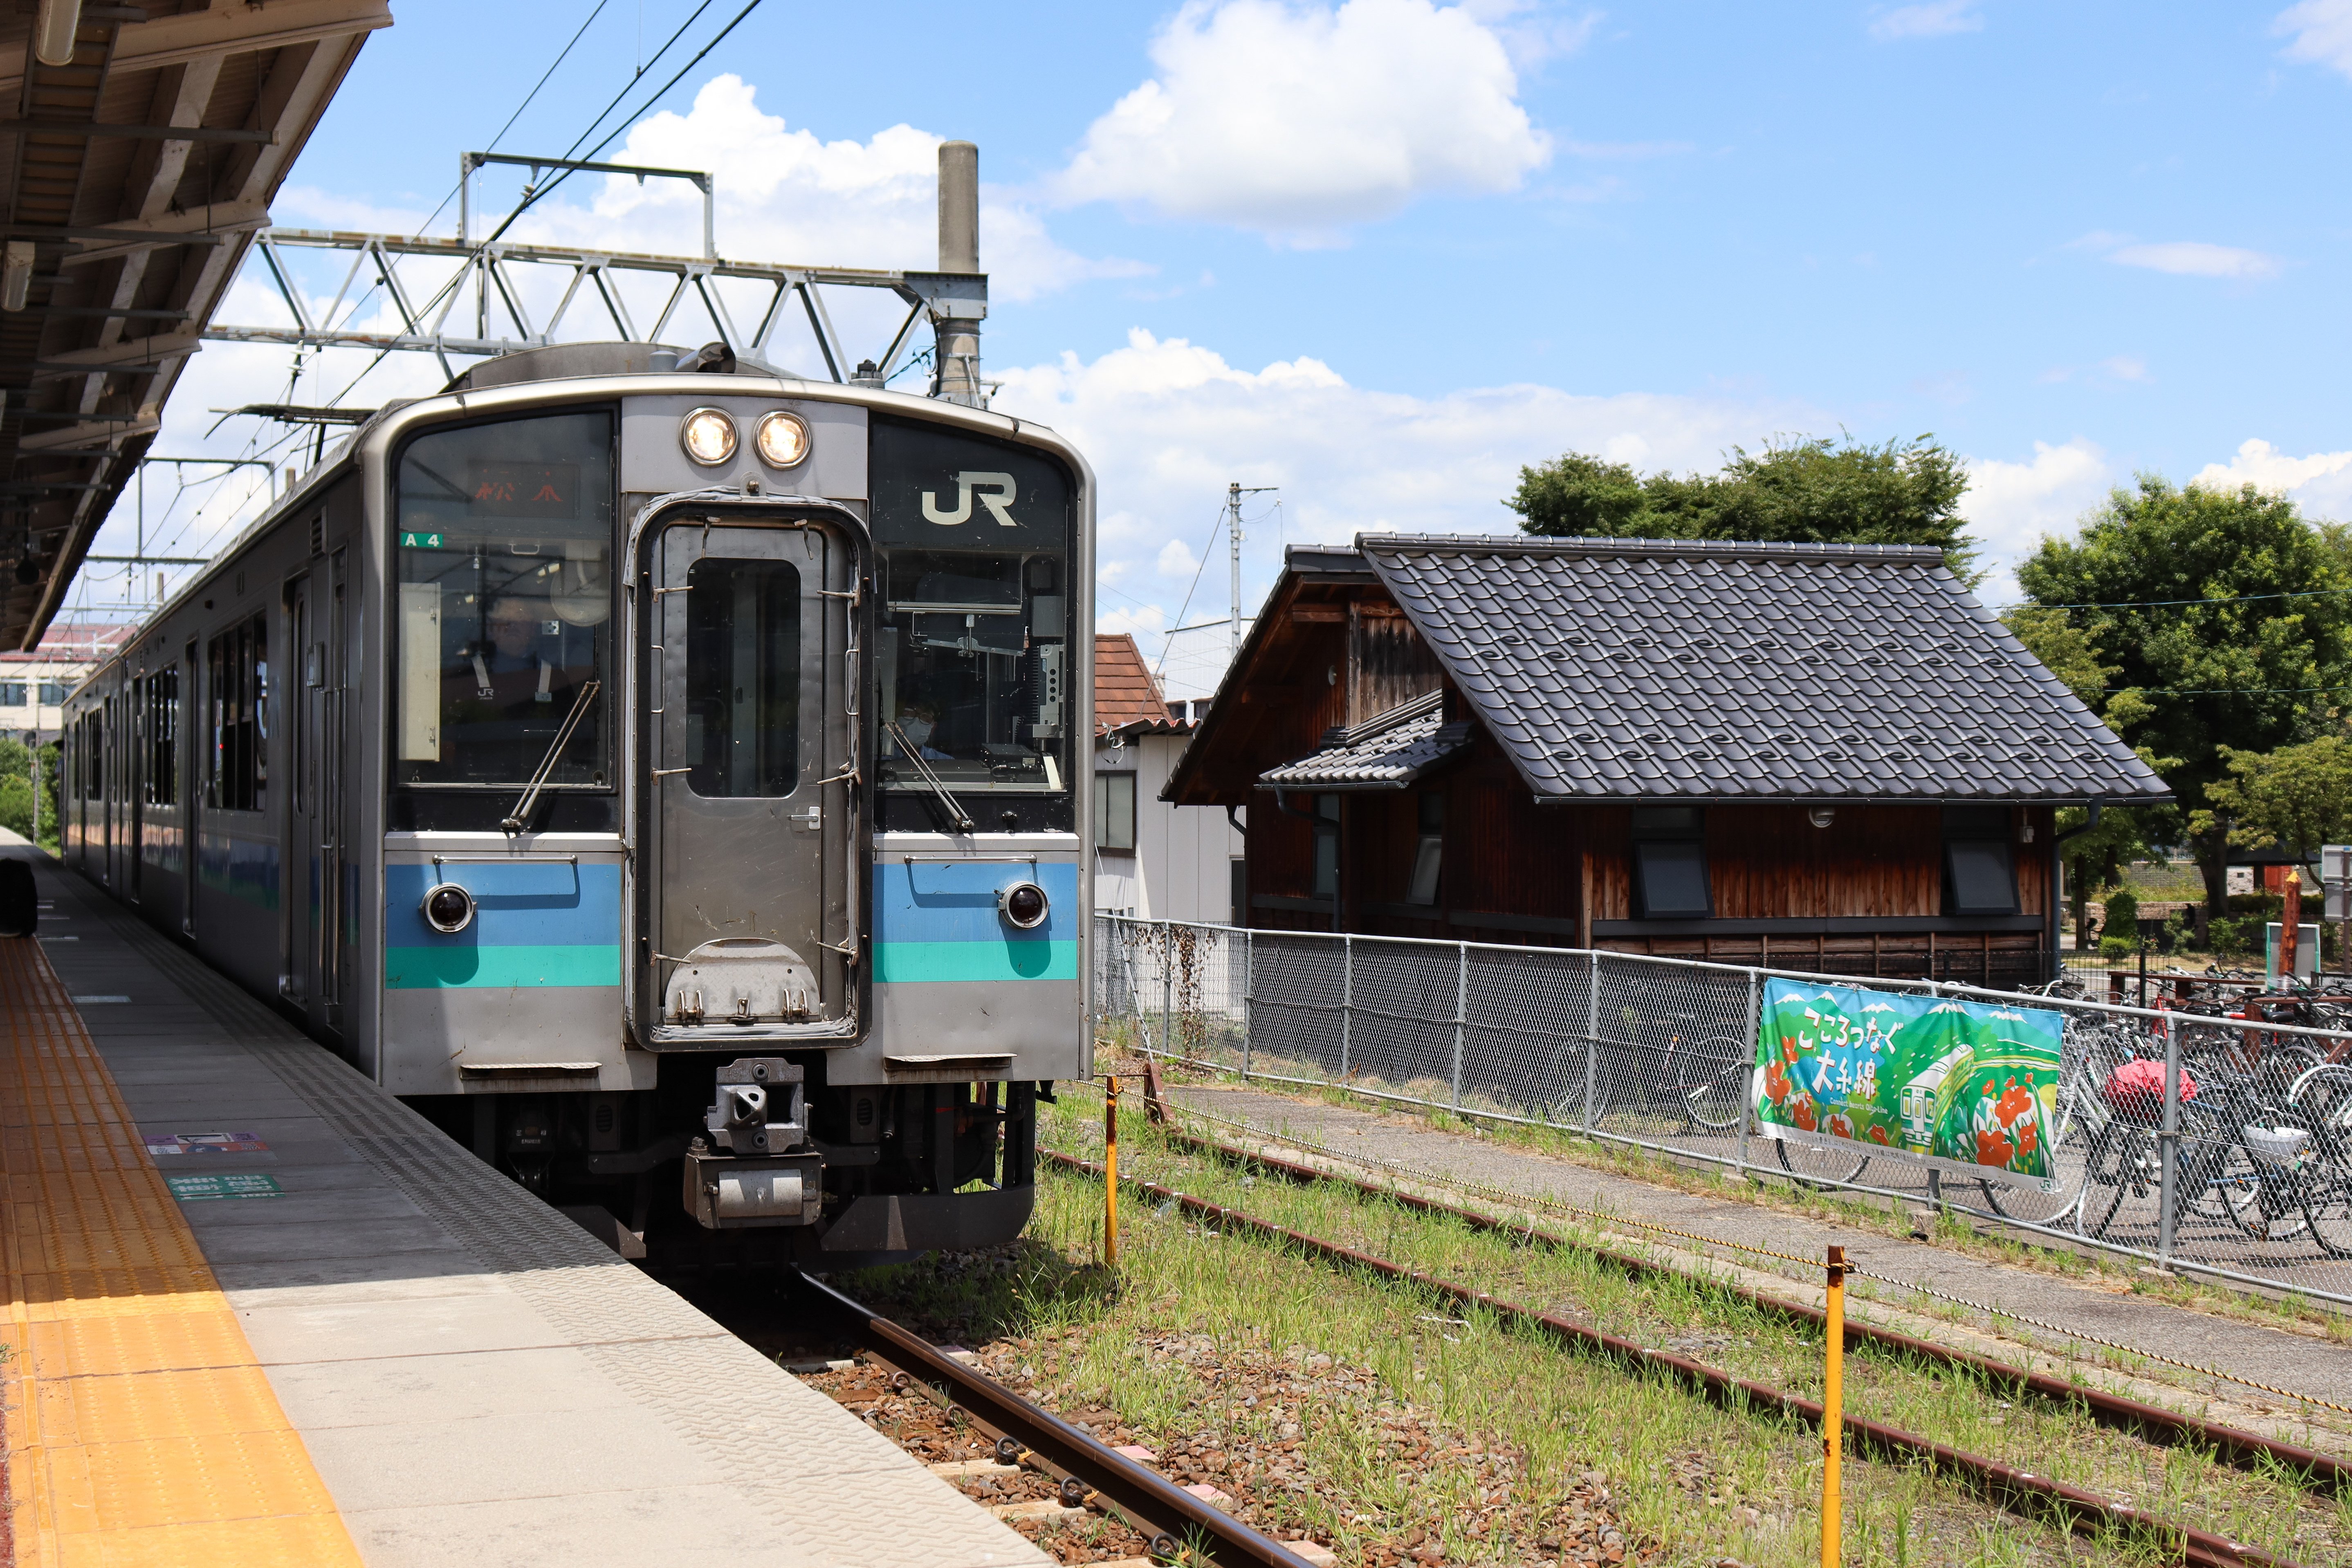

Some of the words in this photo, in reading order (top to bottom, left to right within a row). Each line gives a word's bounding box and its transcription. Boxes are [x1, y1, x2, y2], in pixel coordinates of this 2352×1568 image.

[922, 471, 1017, 526] JR
[405, 533, 417, 546] A
[427, 534, 439, 547] 4
[1798, 1006, 1903, 1054] こころつなぐ
[1811, 1049, 1876, 1101] 大糸線
[1829, 1097, 1848, 1107] Connect
[1849, 1101, 1864, 1110] hearts
[2040, 1180, 2051, 1189] JR
